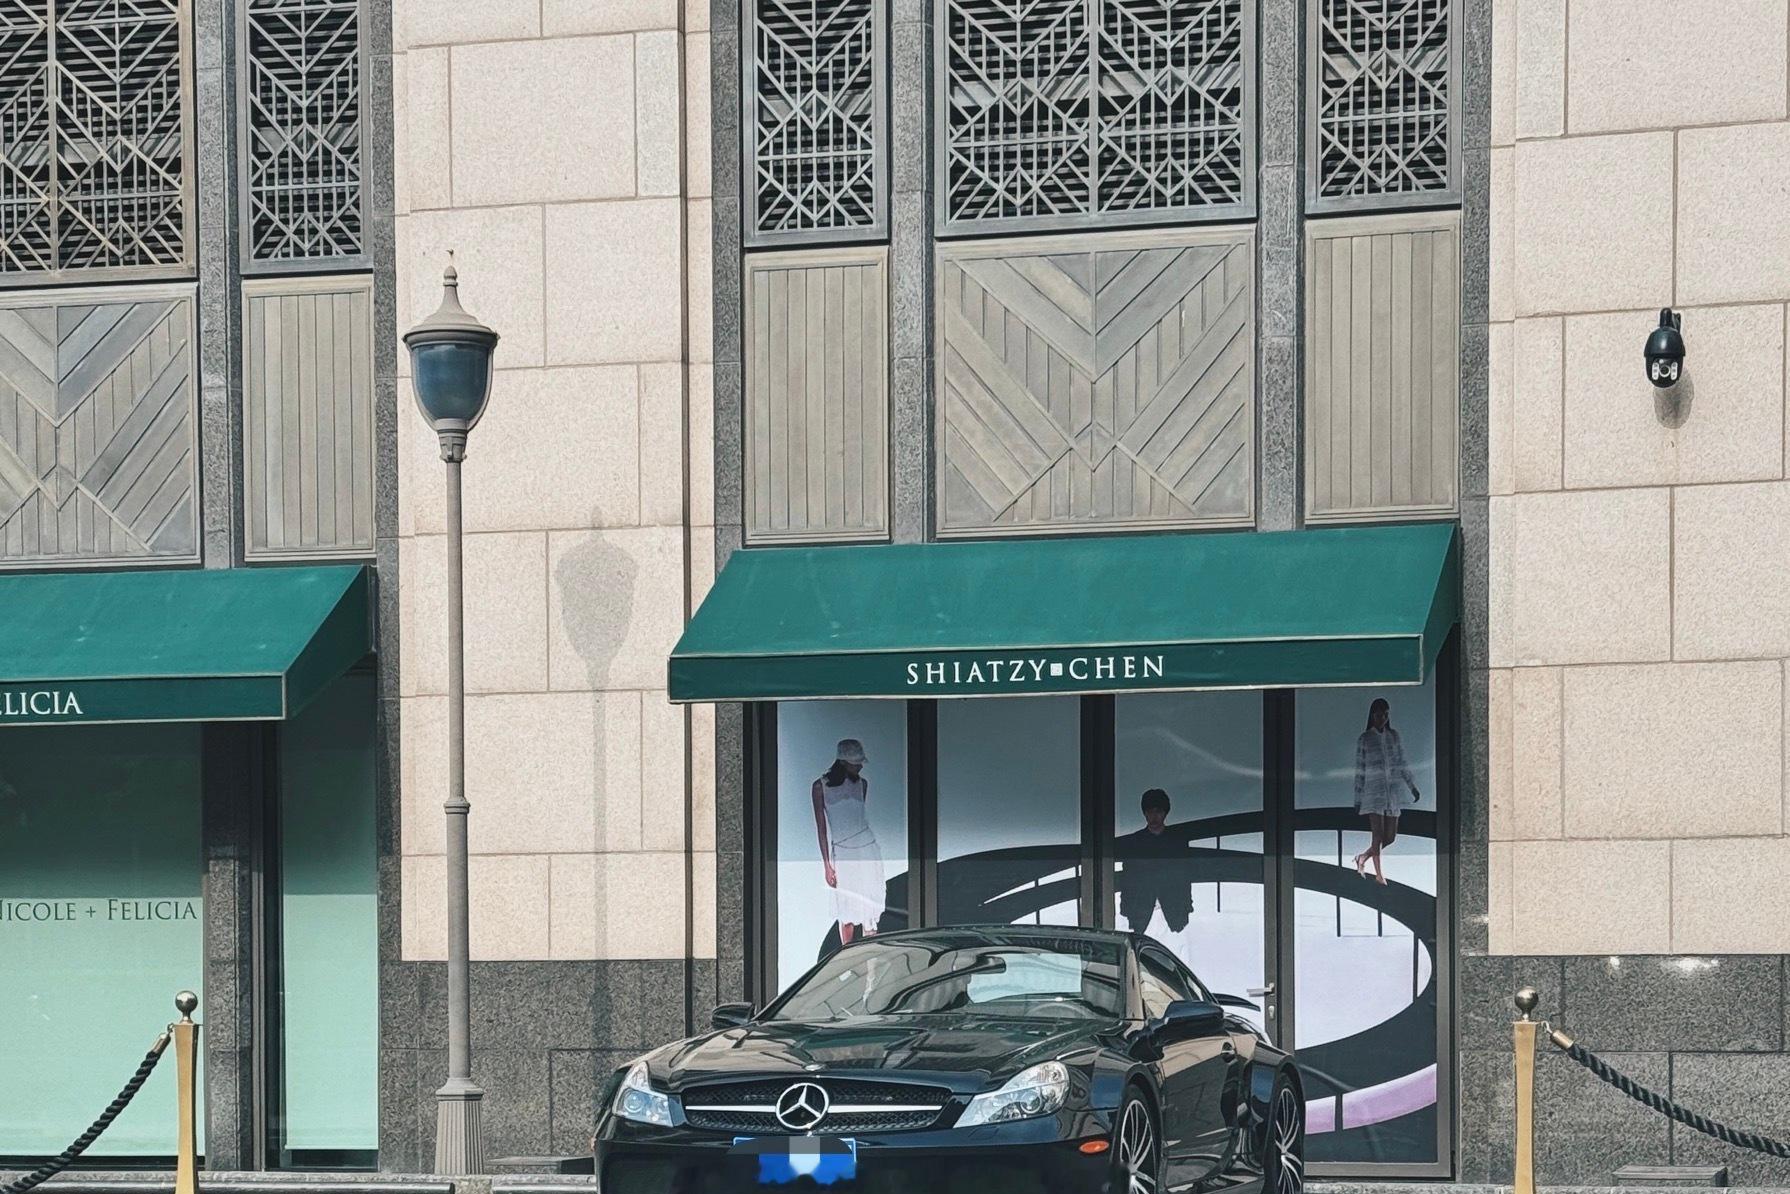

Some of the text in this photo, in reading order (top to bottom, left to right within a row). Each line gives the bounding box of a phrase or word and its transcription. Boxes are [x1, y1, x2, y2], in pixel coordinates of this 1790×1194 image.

[906, 655, 1164, 685] SHIATZY CHEN
[0, 691, 84, 715] LICIA
[0, 898, 198, 922] ICOLE + FELICIA
